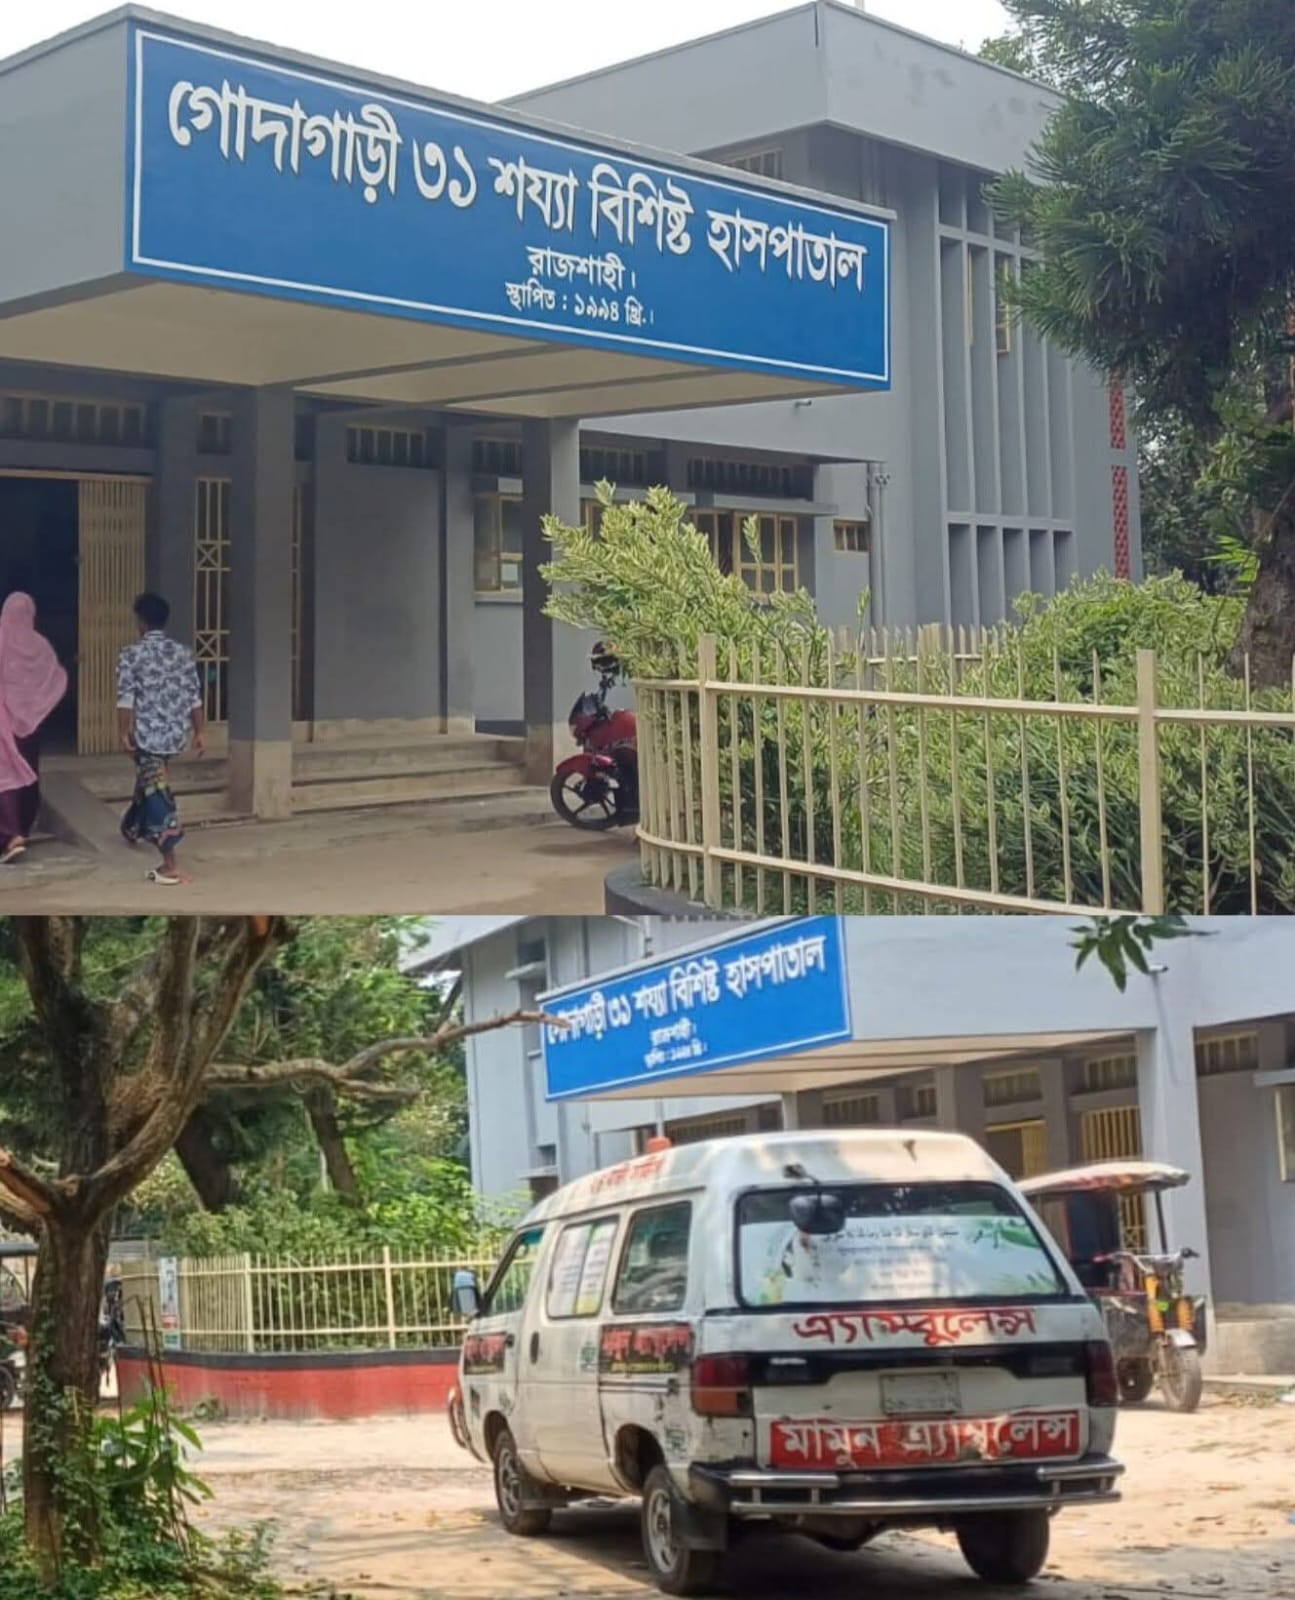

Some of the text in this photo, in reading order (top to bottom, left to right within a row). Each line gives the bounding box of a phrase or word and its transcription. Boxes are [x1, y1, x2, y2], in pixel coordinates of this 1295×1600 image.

[168, 78, 868, 292] গোদাগাড়ী ৩১ শয্যা বিশিষ্ট হাসপাতাল
[574, 293, 620, 322] ১৯৯৪
[724, 935, 826, 999] হাসপাতাল
[778, 1419, 884, 1468] মামুন
